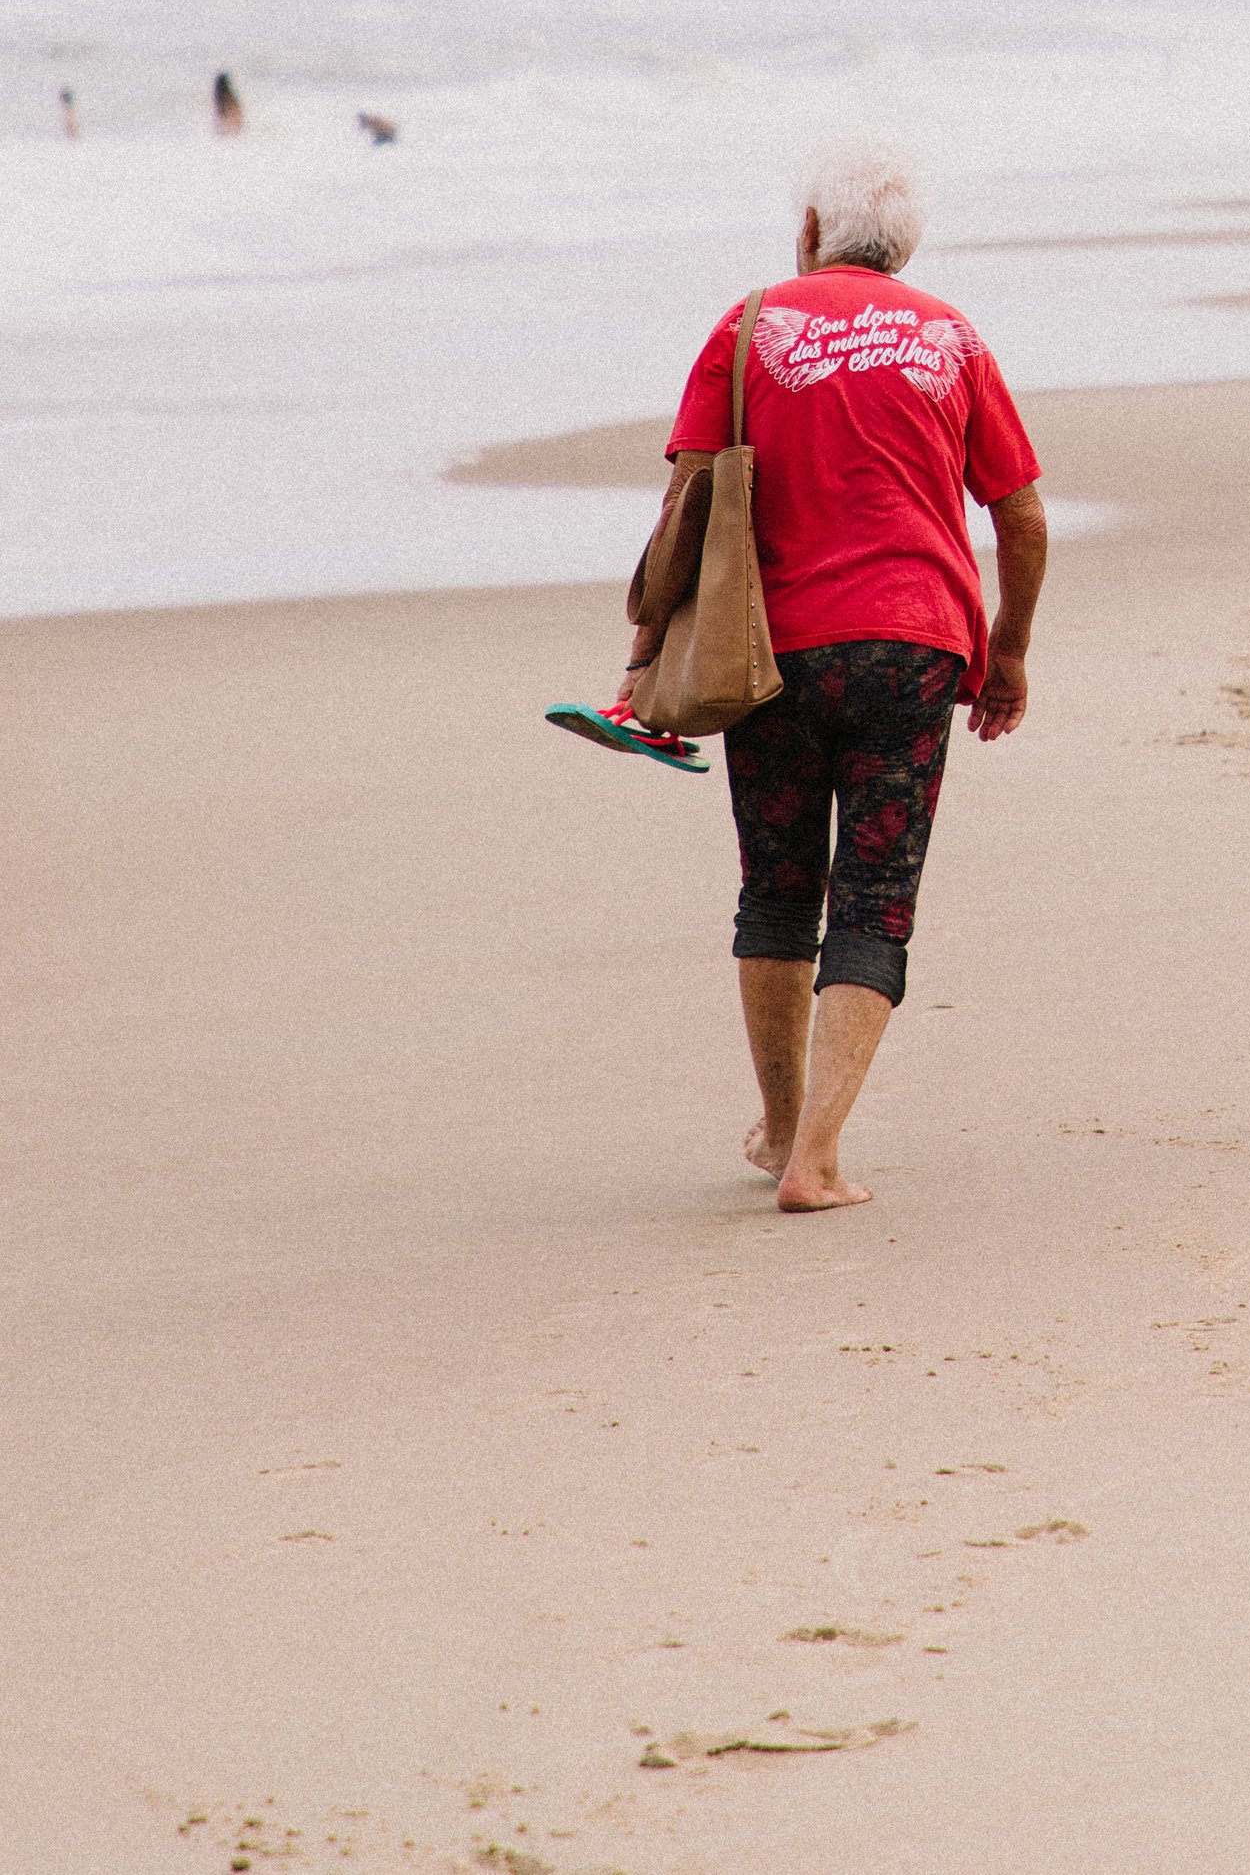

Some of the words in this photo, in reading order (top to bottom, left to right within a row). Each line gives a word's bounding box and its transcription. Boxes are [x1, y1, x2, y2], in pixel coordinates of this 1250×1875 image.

[807, 316, 847, 339] Sou
[853, 304, 919, 327] dona
[788, 341, 822, 364] das
[827, 327, 898, 354] minhas
[848, 338, 941, 372] escolhas
